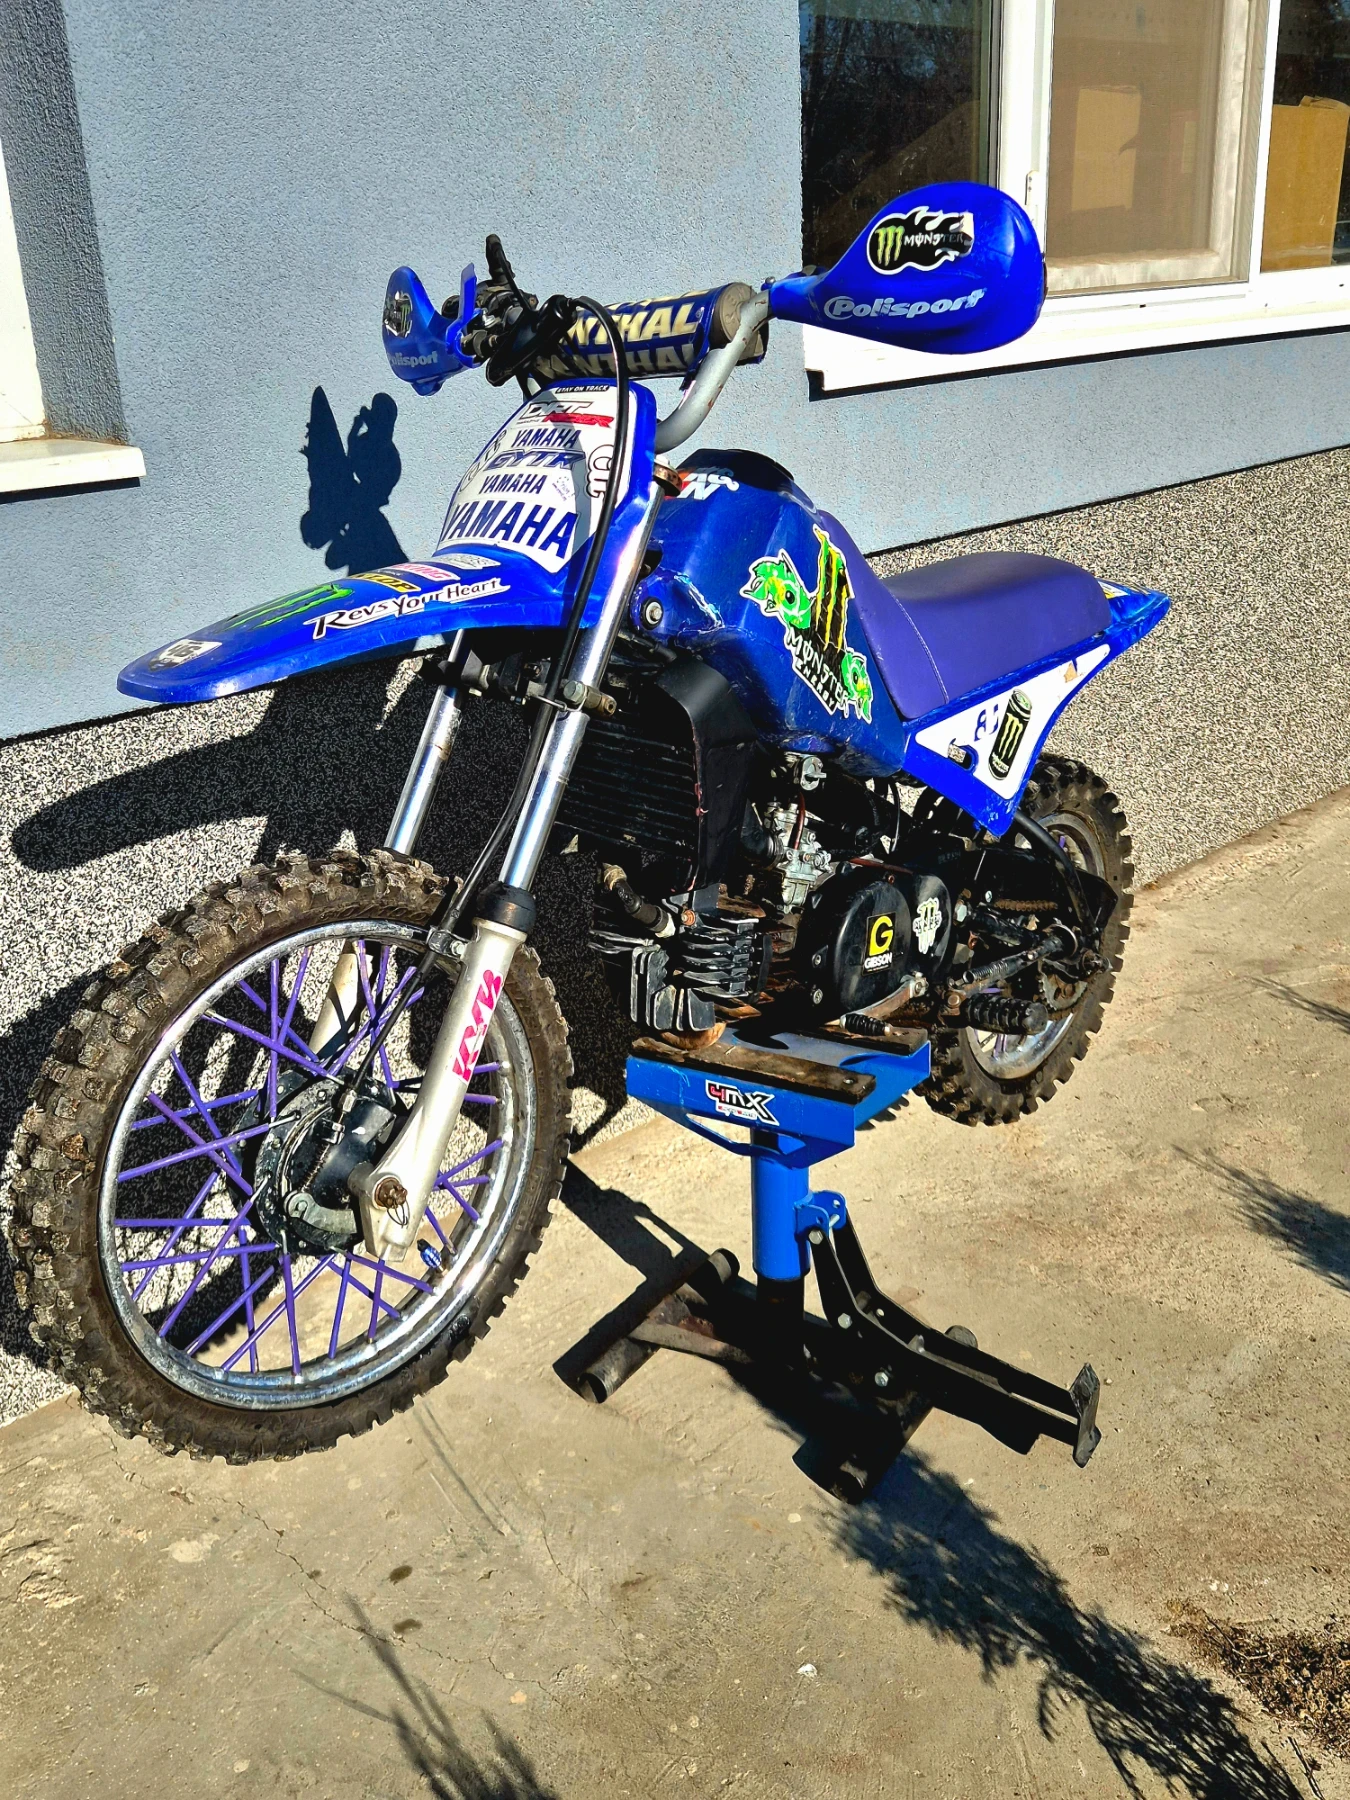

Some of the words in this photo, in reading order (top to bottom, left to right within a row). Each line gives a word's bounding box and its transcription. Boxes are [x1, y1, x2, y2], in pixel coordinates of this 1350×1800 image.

[824, 289, 986, 320] Polisport
[511, 428, 582, 448] YAMAHA
[483, 448, 586, 472] GYTR
[478, 474, 547, 495] YAMAHA
[440, 500, 578, 560] YAMAHA
[313, 602, 388, 637] Revs
[392, 592, 444, 616] Your
[447, 579, 499, 600] Heart
[869, 915, 894, 956] G
[864, 951, 893, 969] GIBSON
